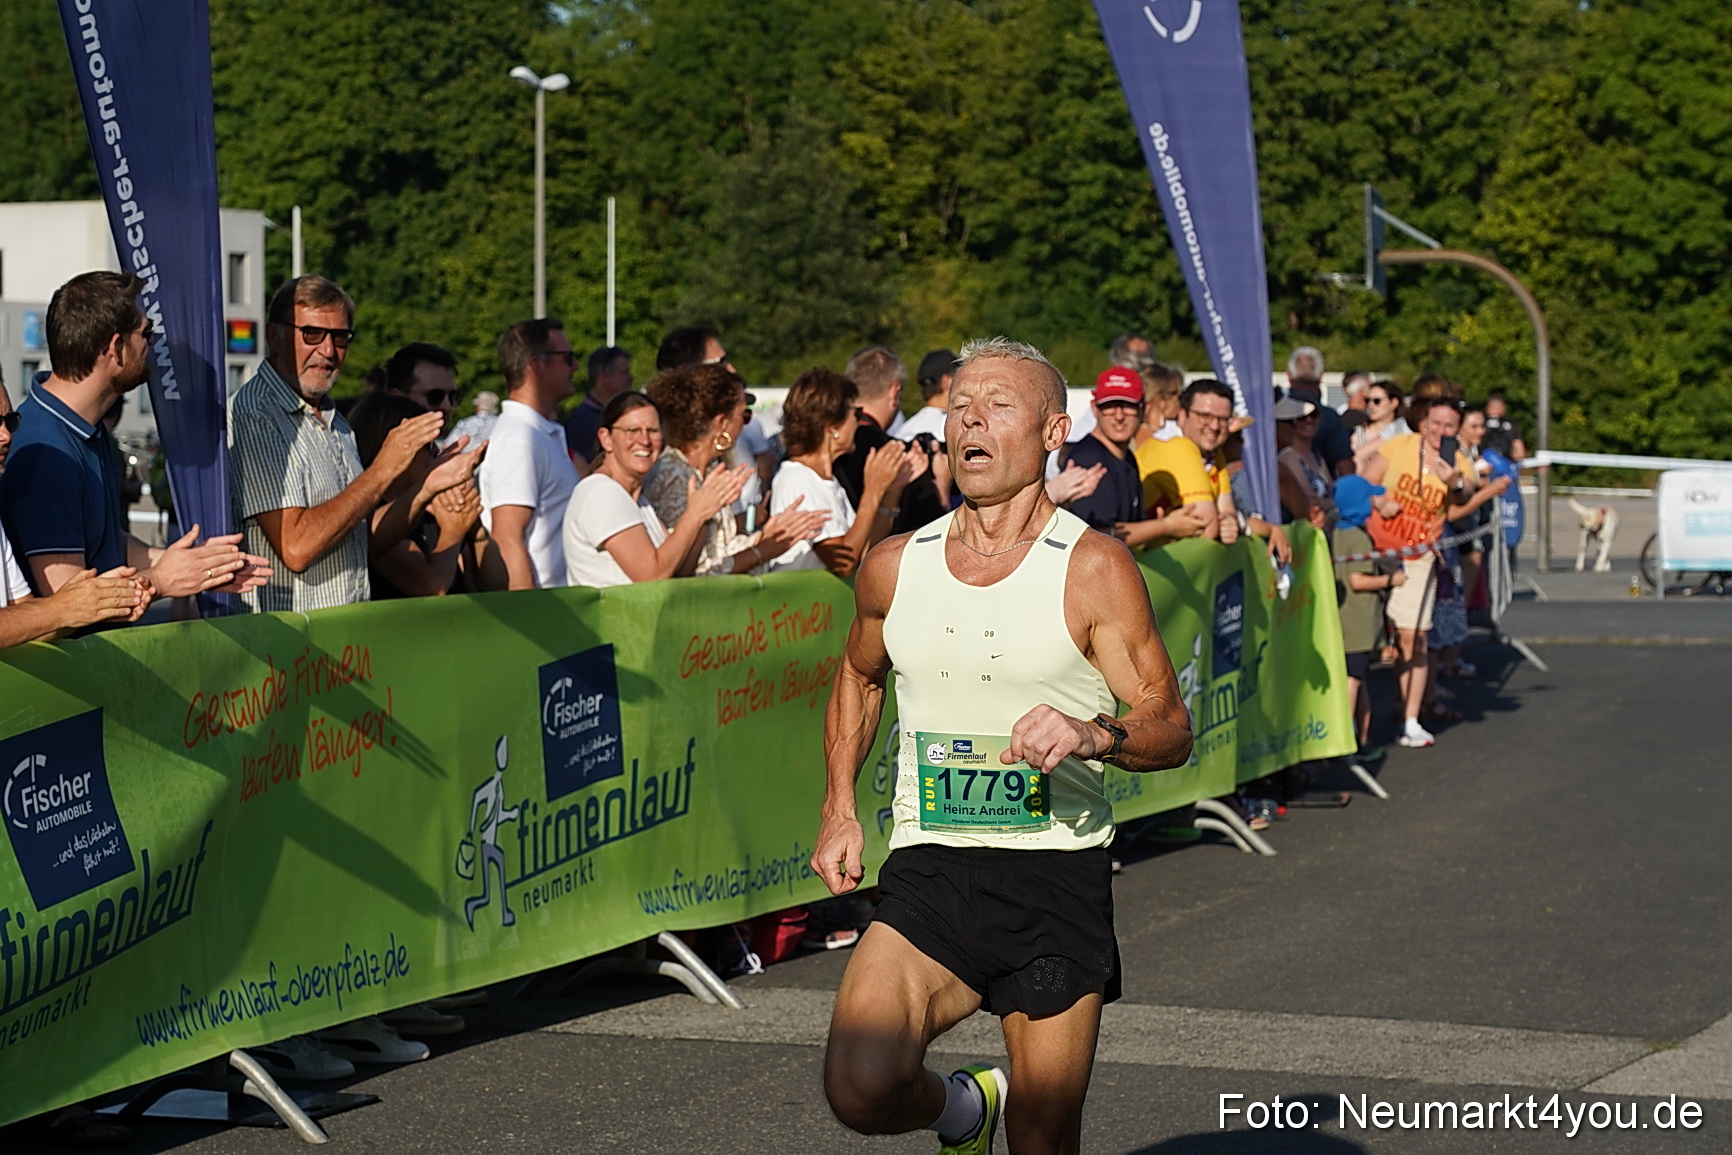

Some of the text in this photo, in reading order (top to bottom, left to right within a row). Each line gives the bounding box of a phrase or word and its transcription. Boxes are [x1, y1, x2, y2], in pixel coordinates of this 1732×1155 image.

[680, 602, 833, 680] Gesunde Firmen
[945, 626, 954, 634] 14
[984, 630, 995, 638] 09
[940, 670, 949, 679] 11
[981, 674, 992, 682] 05
[184, 644, 372, 749] Gesunde Firmen
[554, 693, 603, 727] Fischer
[717, 667, 775, 727] laufen
[239, 687, 396, 805] laufen länger!
[947, 752, 987, 760] Firmenlauf
[21, 771, 91, 818] Fischer
[925, 777, 936, 811] RUN
[937, 768, 1026, 802] 1779
[1029, 774, 1043, 818] 2022
[36, 800, 94, 834] AUTOMOBILE
[517, 736, 696, 878] firmenlauf
[943, 803, 1021, 816] Heinz Andrei
[523, 856, 595, 913] neumarkt
[0, 819, 214, 1008] firmenlauf
[136, 932, 411, 1048] www.firmenlauf-oberpfalz.de
